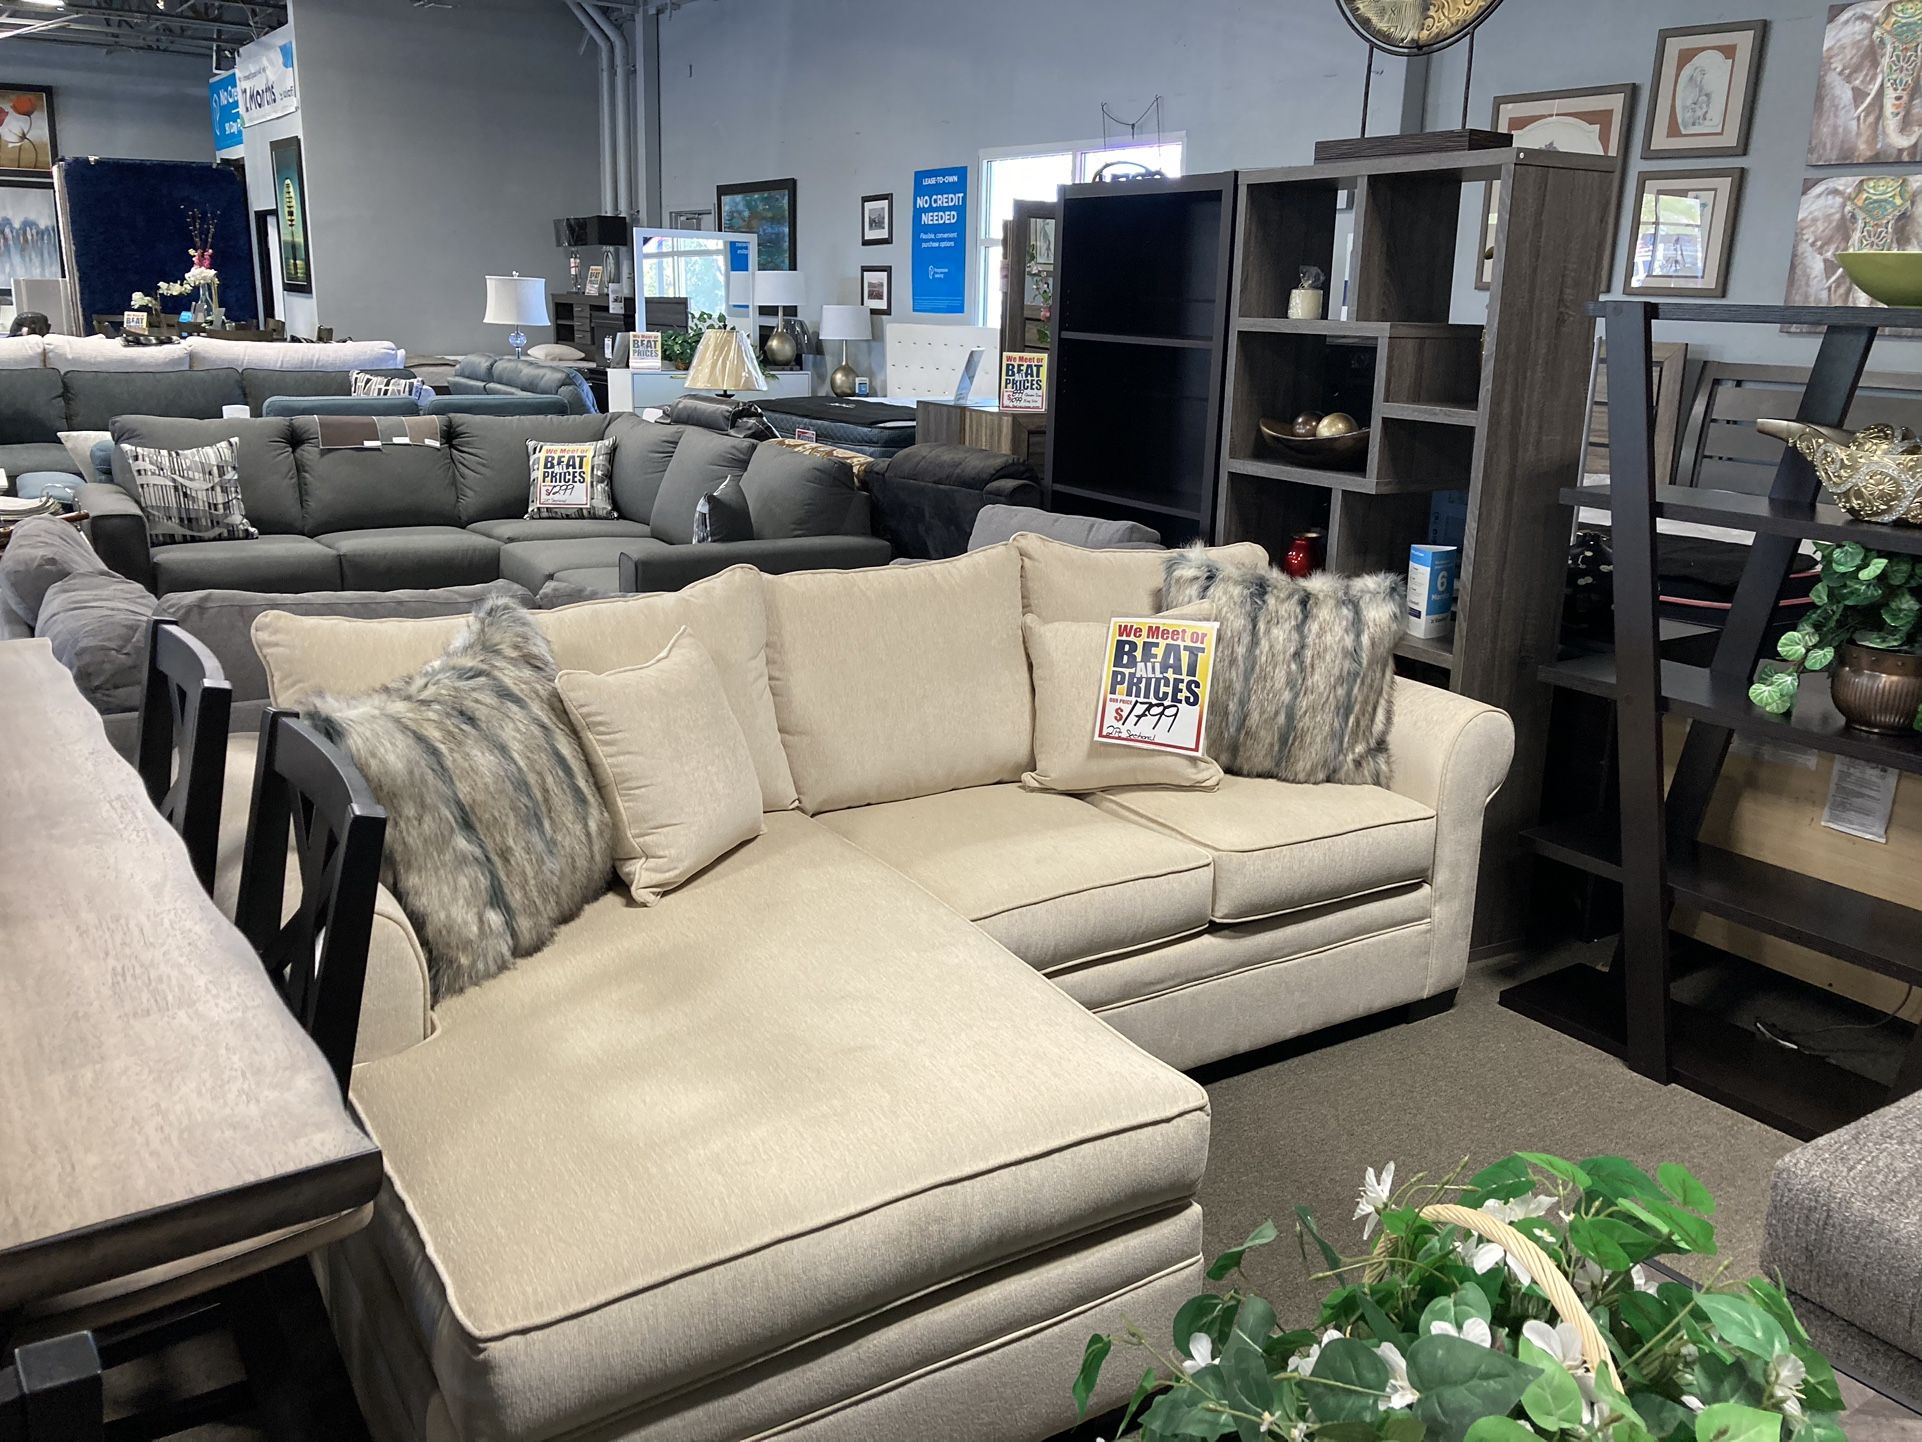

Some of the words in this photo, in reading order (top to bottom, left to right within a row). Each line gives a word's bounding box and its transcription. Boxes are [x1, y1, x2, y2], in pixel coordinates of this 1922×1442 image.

[219, 89, 228, 106] No
[922, 175, 958, 185] LEASE-TO-OWN
[916, 195, 930, 208] NO
[931, 192, 964, 208] CREDIT
[921, 211, 957, 225] NEEDED
[633, 339, 658, 349] BEAT
[633, 349, 659, 357] PRICES
[1006, 355, 1016, 363] We
[1006, 363, 1043, 378] BEAT
[1005, 378, 1042, 390] PRICES
[543, 455, 587, 469] BEAT
[542, 471, 586, 484] PRICES
[1436, 570, 1448, 592] 6
[1117, 624, 1143, 639] We
[1146, 625, 1187, 641] Meet
[1190, 631, 1208, 645] or
[1112, 639, 1206, 678] BEAT
[1135, 661, 1165, 678] ALL
[1109, 669, 1201, 707] PRICES
